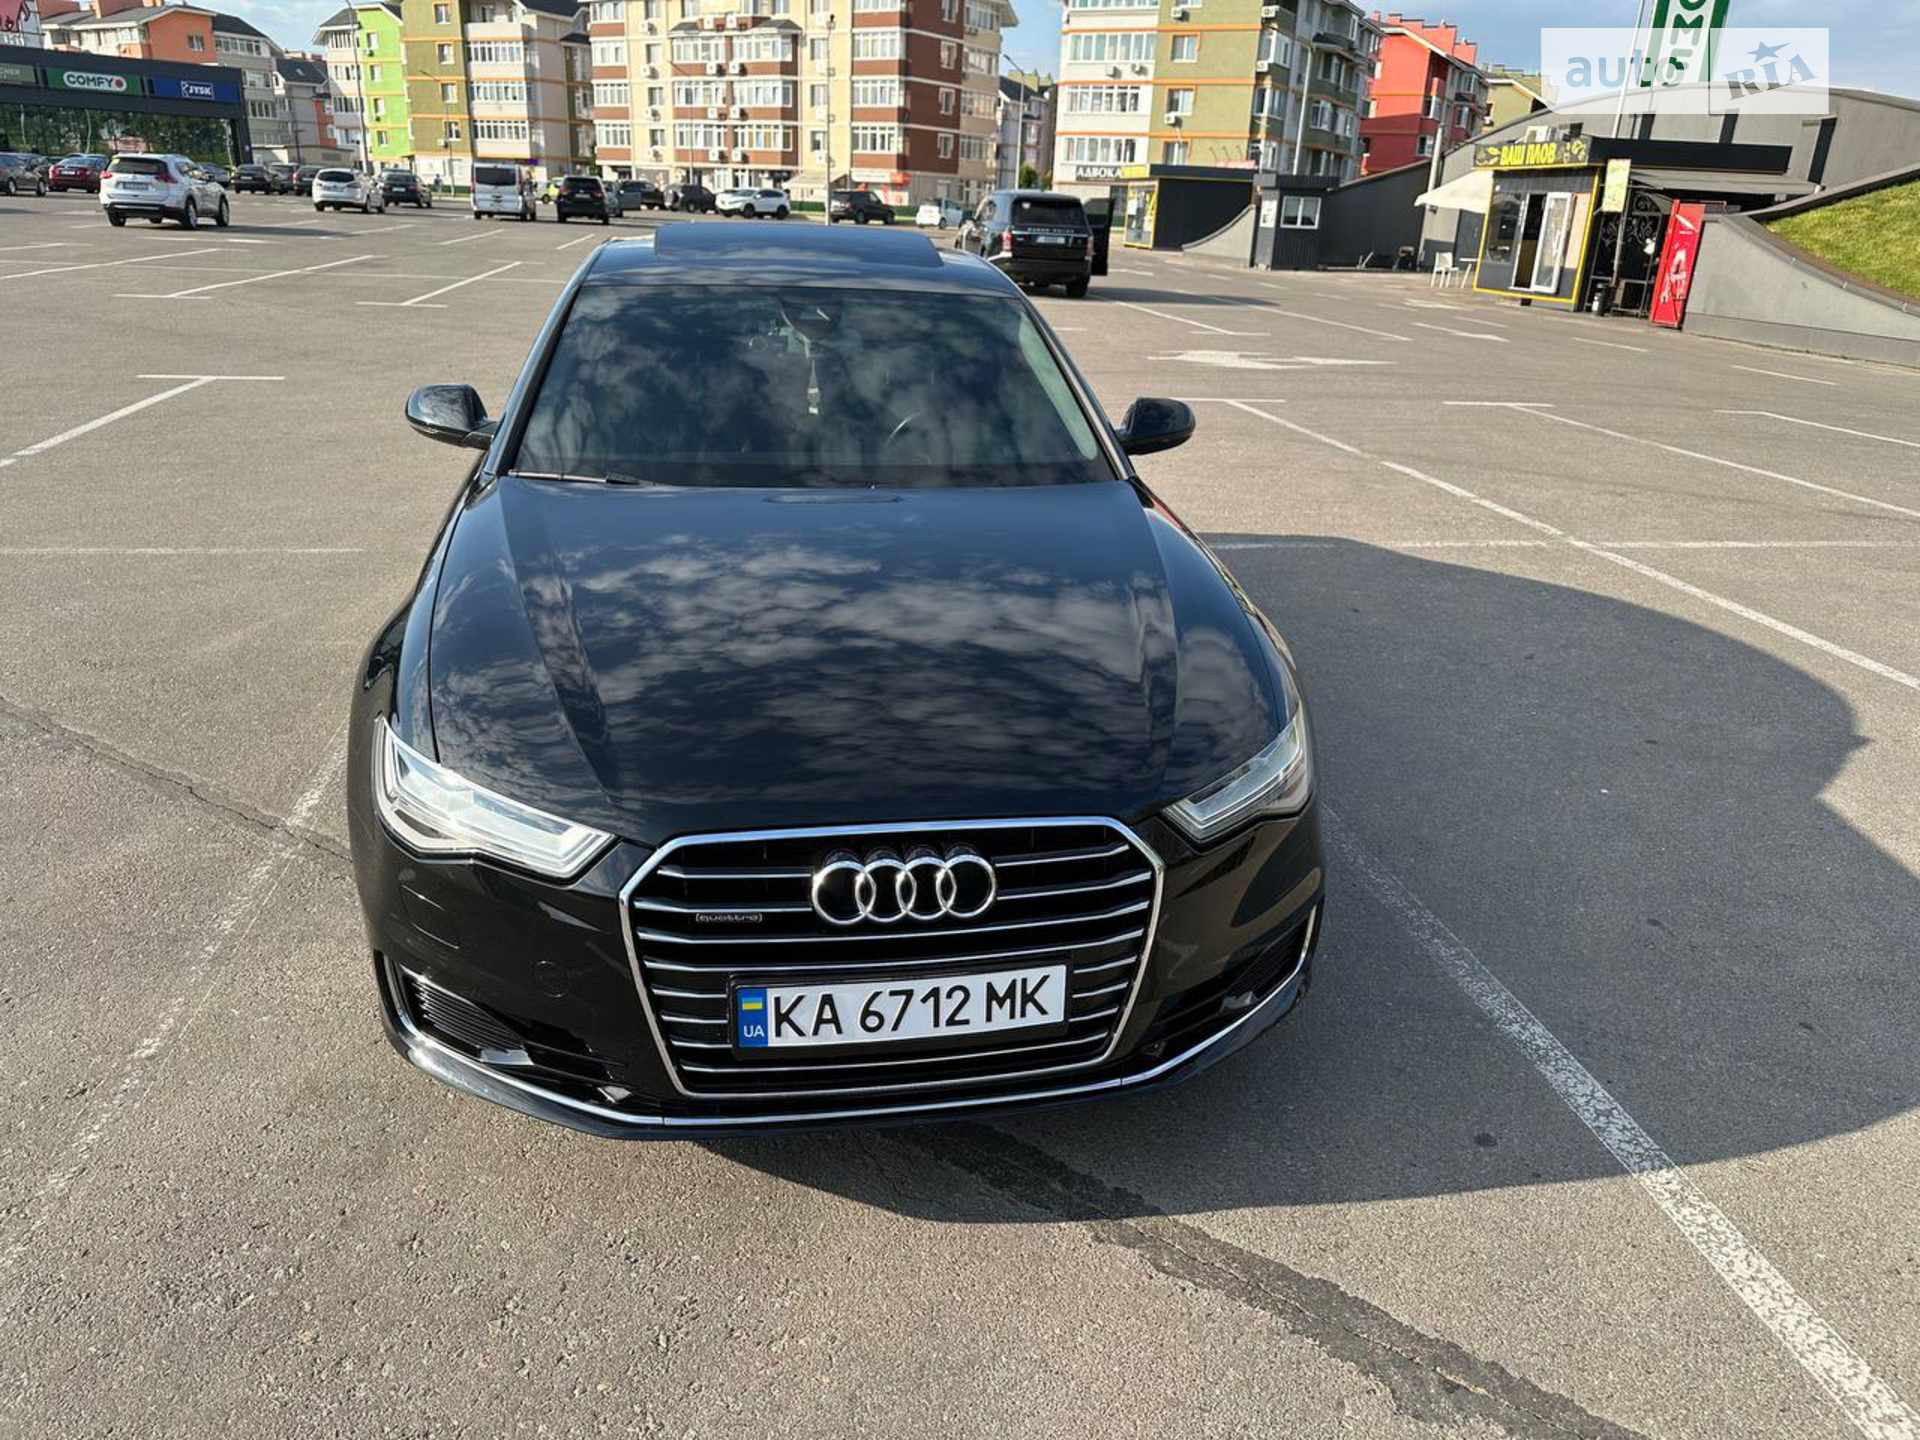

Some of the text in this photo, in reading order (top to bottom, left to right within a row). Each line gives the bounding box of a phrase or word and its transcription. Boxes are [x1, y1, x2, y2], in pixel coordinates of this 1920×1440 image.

[66, 74, 114, 88] COMFY
[188, 85, 212, 95] JYSK
[1500, 142, 1557, 166] ВАШ ПЛОВ
[1077, 166, 1122, 178] АДВОКА
[774, 974, 1051, 1038] KA 6712 MK
[743, 1025, 765, 1038] UA
